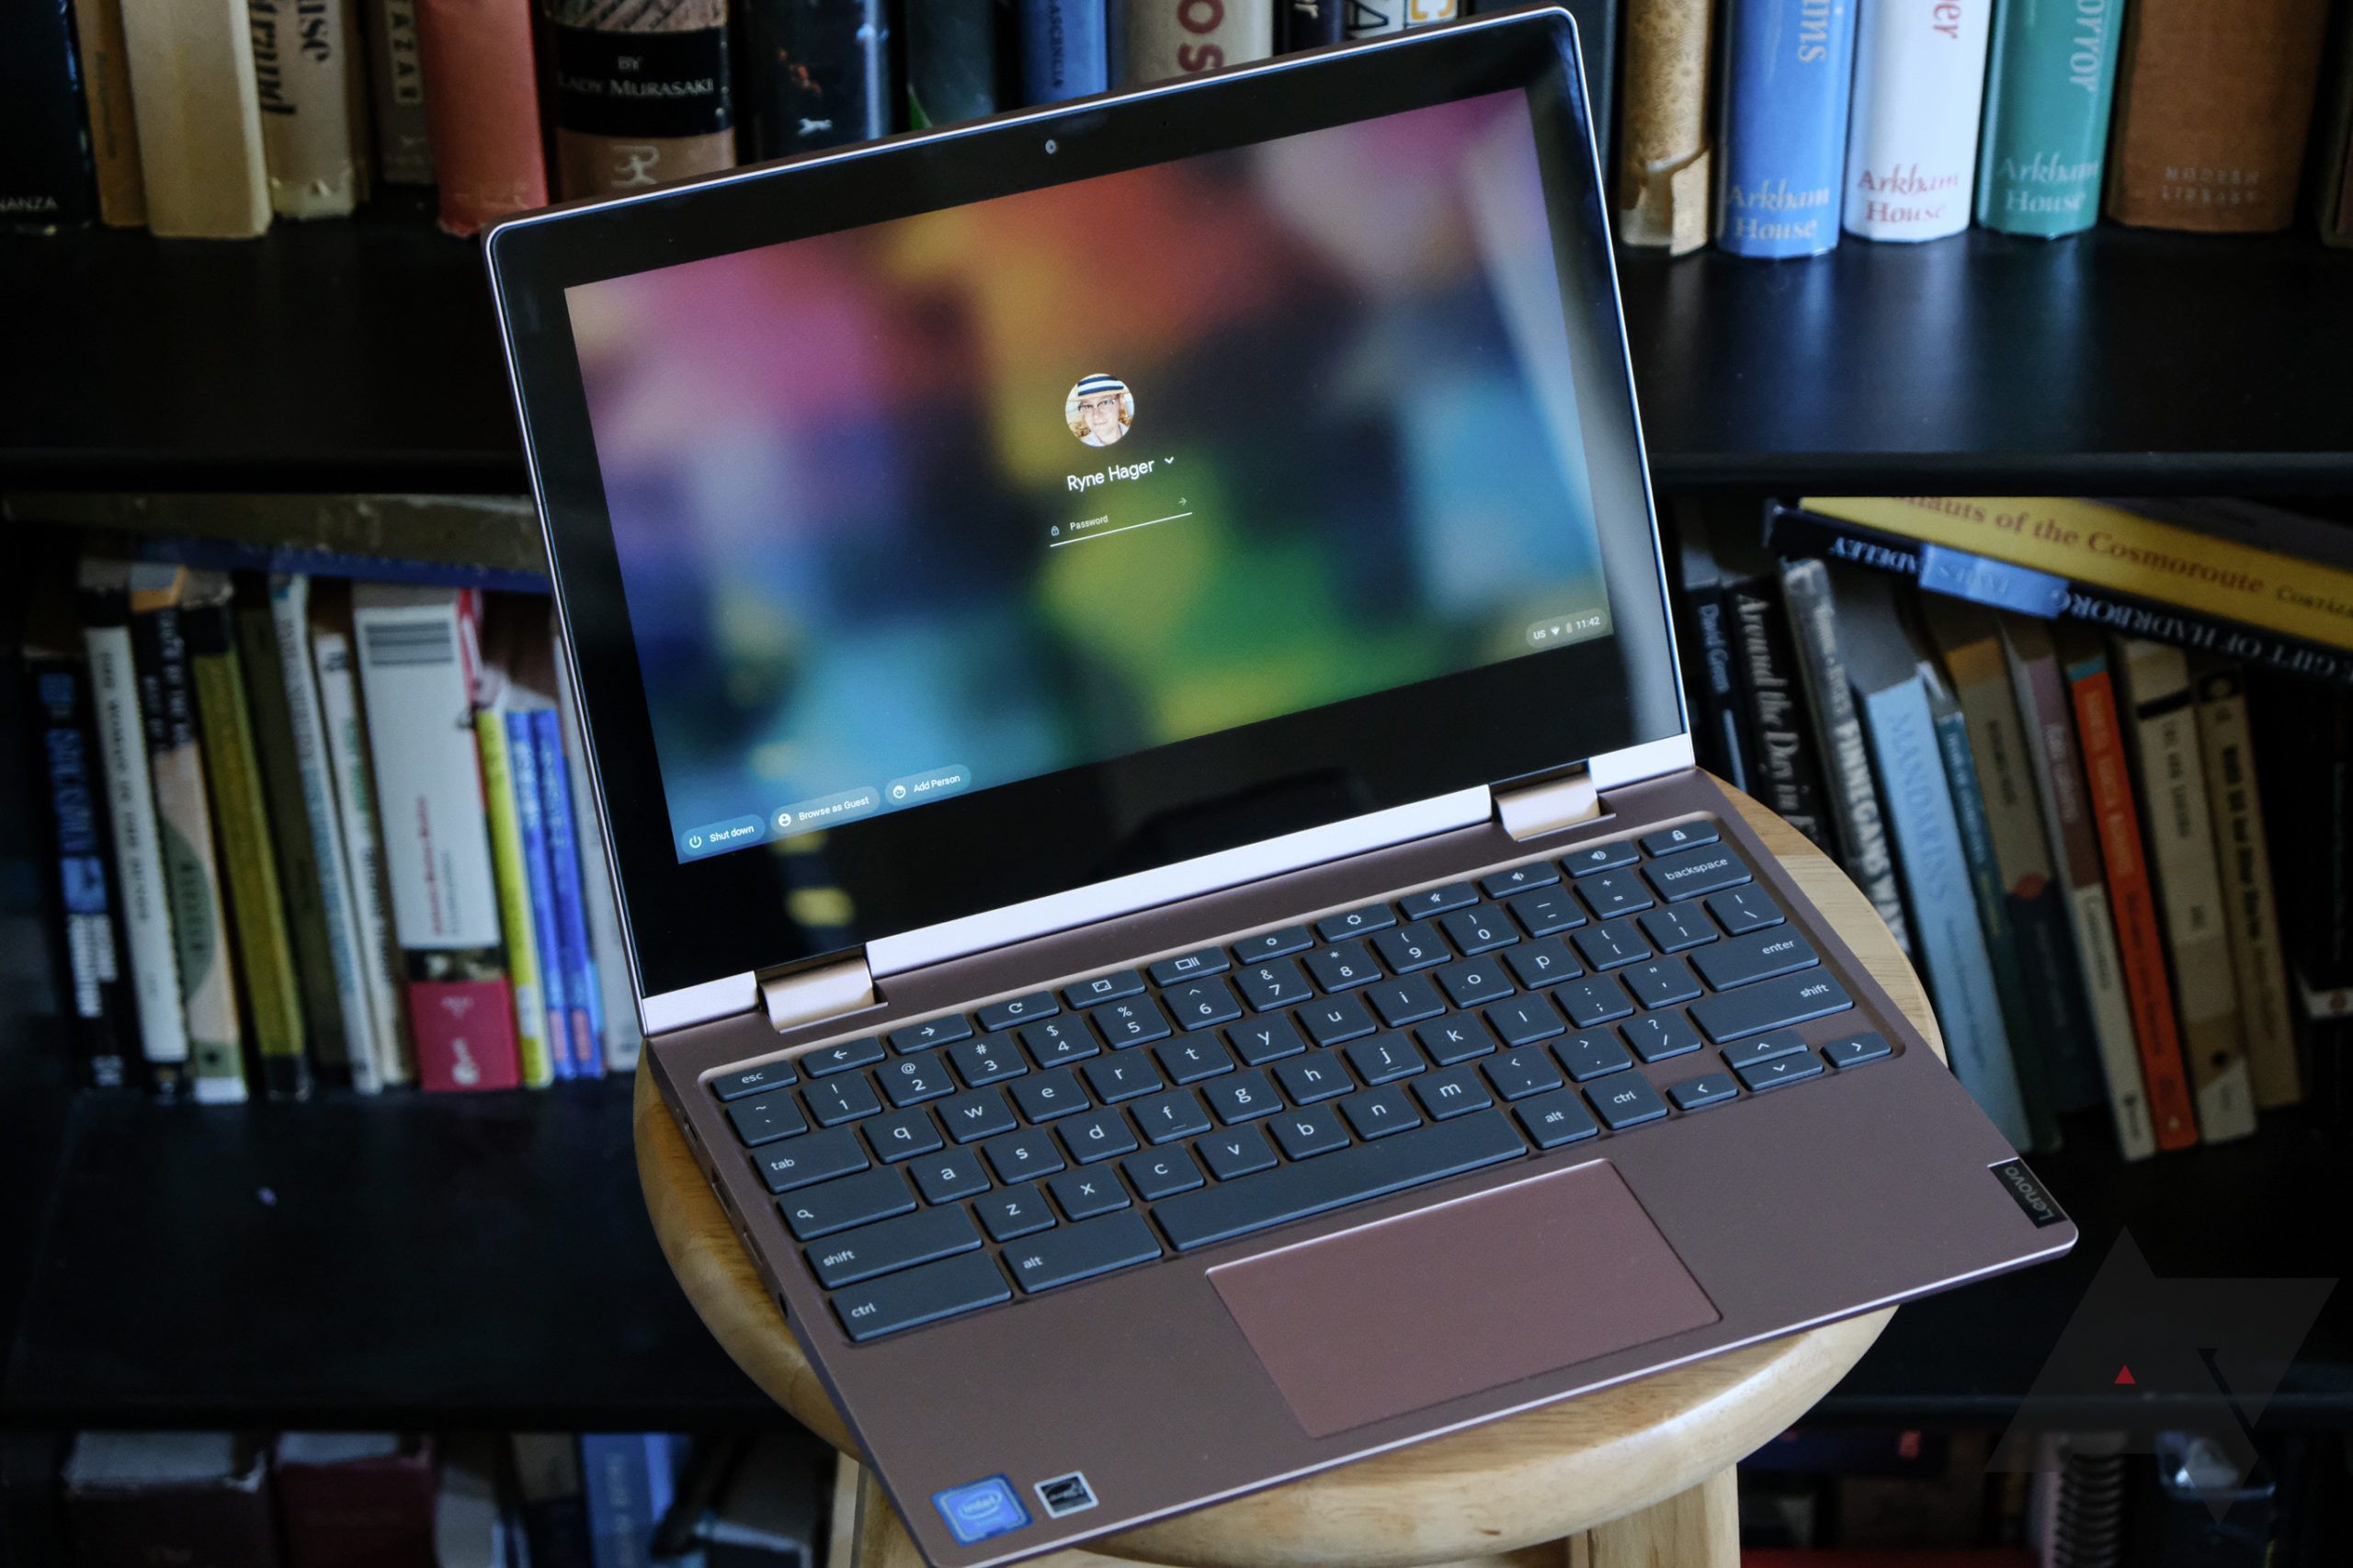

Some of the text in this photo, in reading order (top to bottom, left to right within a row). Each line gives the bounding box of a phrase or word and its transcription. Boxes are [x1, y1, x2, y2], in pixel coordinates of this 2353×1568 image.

[618, 56, 642, 70] BY
[609, 78, 714, 97] MURASAKI
[1998, 151, 2098, 184] Arkham
[1859, 164, 1959, 196] Arkham
[1728, 178, 1830, 212] Arkham
[2006, 188, 2086, 213] House
[1865, 199, 1946, 223] House
[1734, 215, 1818, 241] House
[1067, 460, 1154, 492] Ryne Hager
[1070, 515, 1108, 530] Password
[1995, 512, 2029, 534] of
[2033, 517, 2079, 545] the
[2087, 530, 2265, 593] Cosmoroute
[1533, 617, 1600, 640] US 11:42
[1699, 603, 1724, 648] David
[1737, 594, 1789, 687] Around
[2227, 632, 2263, 658] OF
[2271, 645, 2337, 676] GIFT
[1756, 691, 1793, 727] the
[1759, 732, 1799, 778] Day
[914, 774, 961, 793] Add Person
[1776, 783, 1810, 810] in
[799, 796, 870, 821] Browse as Guest
[710, 824, 755, 844] Shut down
[1665, 859, 1728, 880] backspace
[1409, 948, 1422, 958] 9
[1763, 941, 1793, 954] enter
[1536, 956, 1550, 969] p
[1261, 970, 1273, 980] &
[1340, 966, 1353, 976] 8
[1269, 984, 1279, 995] 7
[1801, 984, 1829, 997] shift
[1399, 992, 1408, 1003] i
[1118, 1006, 1132, 1017] %
[1199, 1004, 1211, 1014] 6
[1328, 1012, 1342, 1021] u
[1047, 1026, 1058, 1036] $
[1128, 1022, 1140, 1033] 5
[1257, 1031, 1269, 1045] y
[976, 1044, 986, 1054] #
[1059, 1041, 1069, 1051] 4
[1186, 1049, 1199, 1060] t
[1380, 1048, 1391, 1063] j
[902, 1063, 915, 1074] @
[984, 1061, 997, 1071] 3
[742, 1074, 763, 1083] esc
[1115, 1069, 1122, 1079] r
[1304, 1070, 1321, 1081] h
[912, 1080, 926, 1091] 2
[1440, 1085, 1461, 1096] m
[1042, 1088, 1054, 1097] e
[1235, 1088, 1251, 1103] g
[1614, 1091, 1636, 1103] ctrl
[1163, 1107, 1172, 1119] f
[1371, 1105, 1386, 1116] n
[1546, 1111, 1563, 1122] alt
[894, 1127, 911, 1139] q
[1089, 1125, 1104, 1139] d
[1297, 1123, 1314, 1135] b
[771, 1159, 794, 1170] tab
[941, 1168, 956, 1179] a
[2005, 1166, 2055, 1221] Lenovo
[824, 1251, 855, 1266] shift
[1023, 1256, 1042, 1268] alt
[852, 1303, 876, 1317] ctrl
